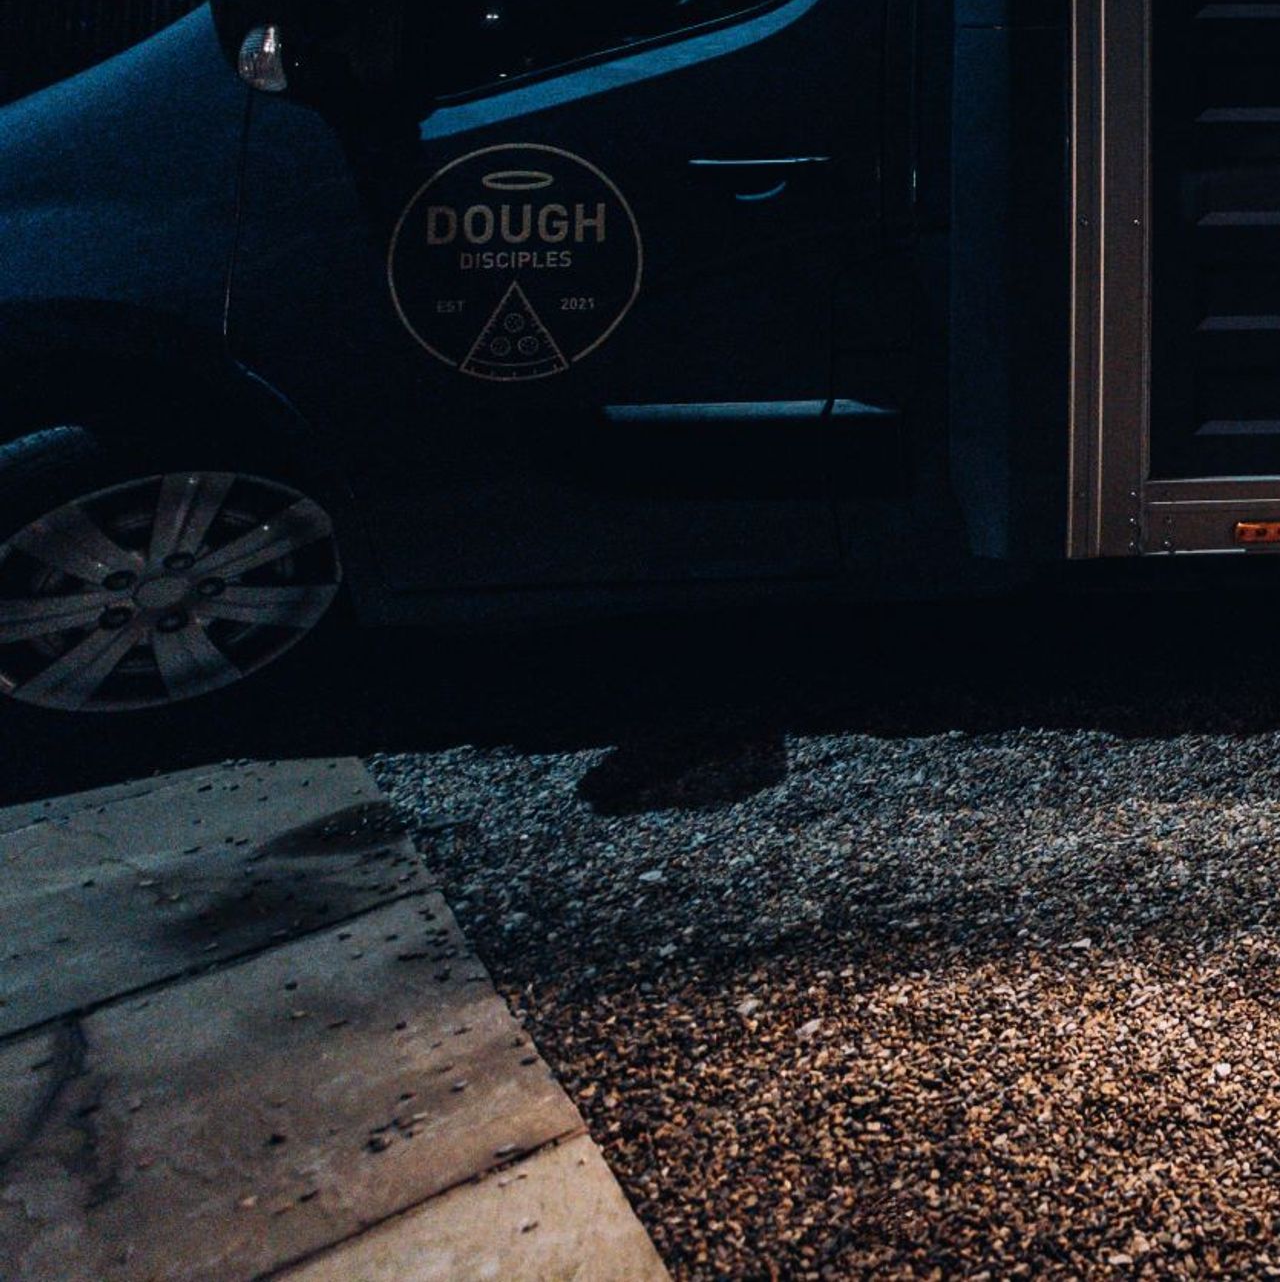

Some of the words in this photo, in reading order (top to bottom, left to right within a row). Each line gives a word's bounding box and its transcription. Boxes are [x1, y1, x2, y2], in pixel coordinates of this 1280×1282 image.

[425, 202, 607, 246] DOUGH
[459, 250, 573, 270] DISCIPLES
[560, 297, 595, 311] 2021
